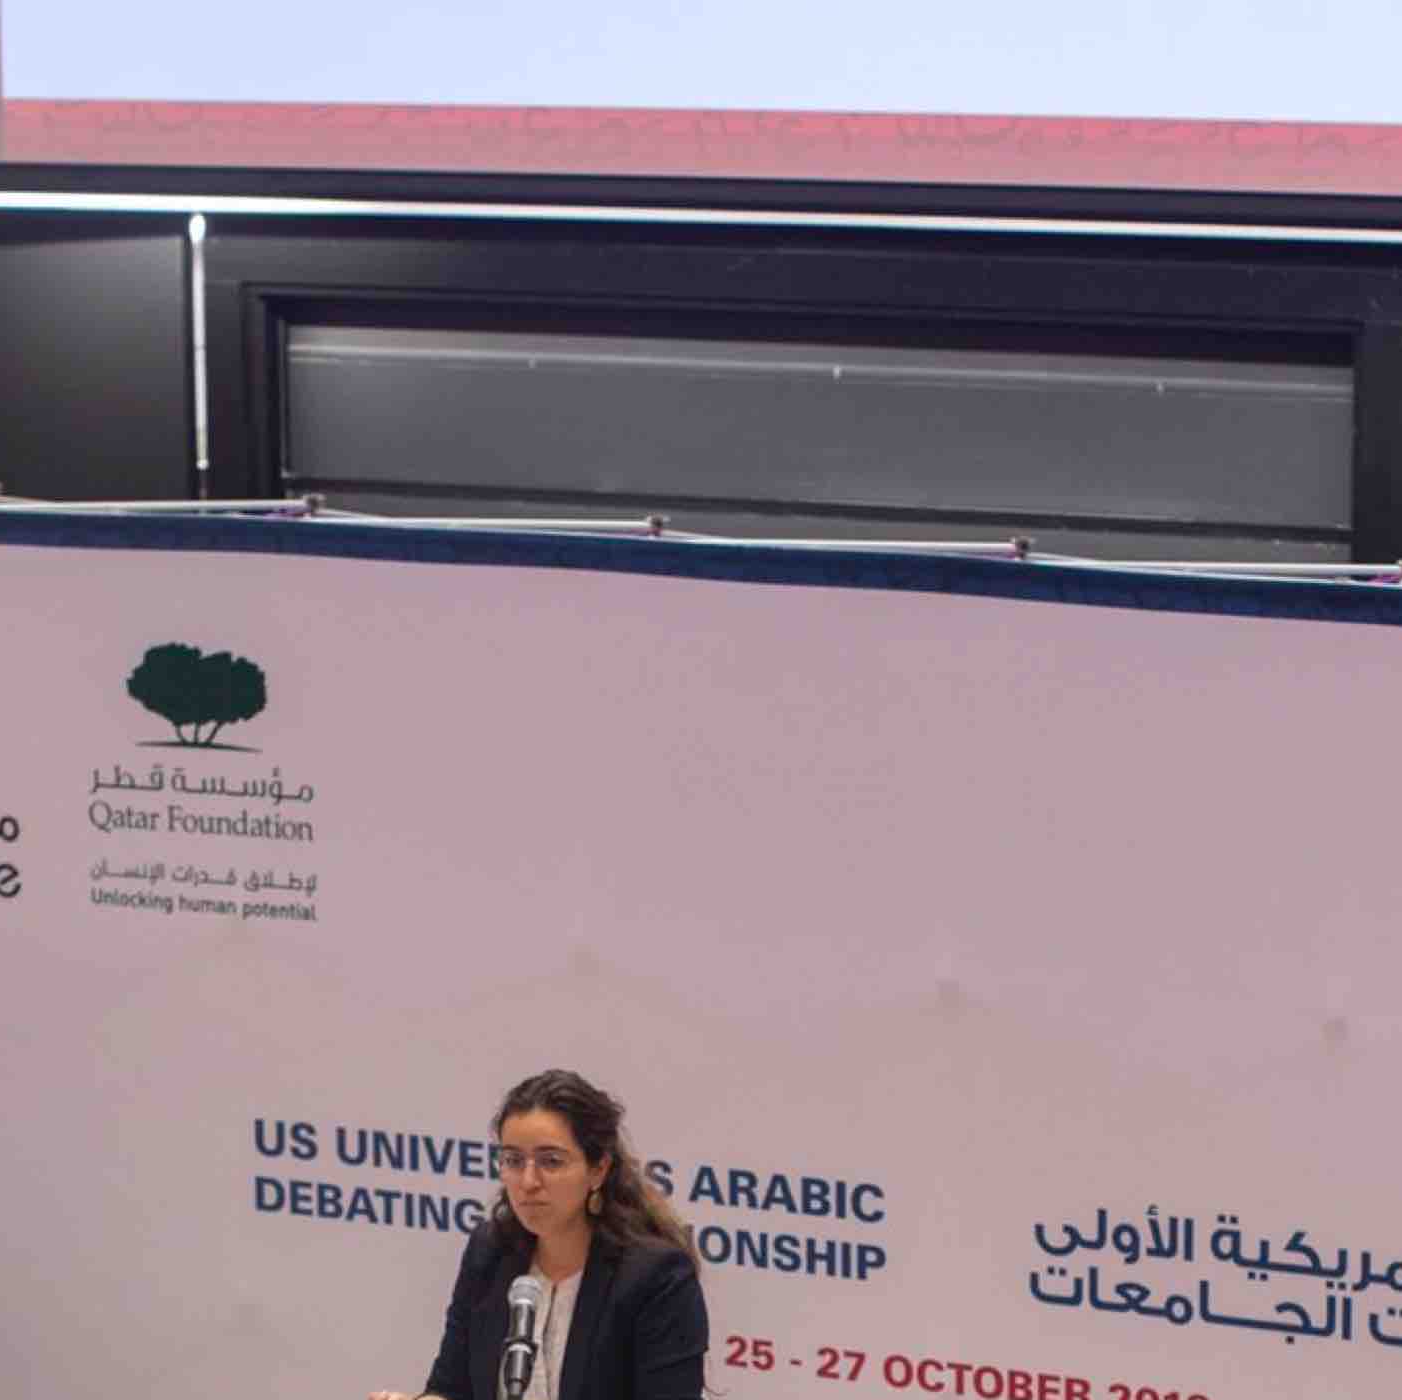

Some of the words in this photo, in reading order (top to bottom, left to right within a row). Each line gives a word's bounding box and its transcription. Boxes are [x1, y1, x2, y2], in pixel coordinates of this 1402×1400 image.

[89, 763, 165, 795] قطر
[170, 765, 315, 805] مؤسسة
[88, 800, 161, 833] Qatar
[166, 804, 315, 841] Foundation
[90, 887, 174, 914] Unlocking
[178, 893, 237, 914] human
[242, 901, 317, 921] potential
[254, 1118, 318, 1161] US
[688, 1165, 886, 1224] ARABIC
[254, 1175, 487, 1234] DEBATING
[1034, 1203, 1195, 1265] الأولى
[1029, 1265, 1353, 1345] الجامعات
[724, 1335, 776, 1371] 25
[815, 1346, 867, 1382] 27
